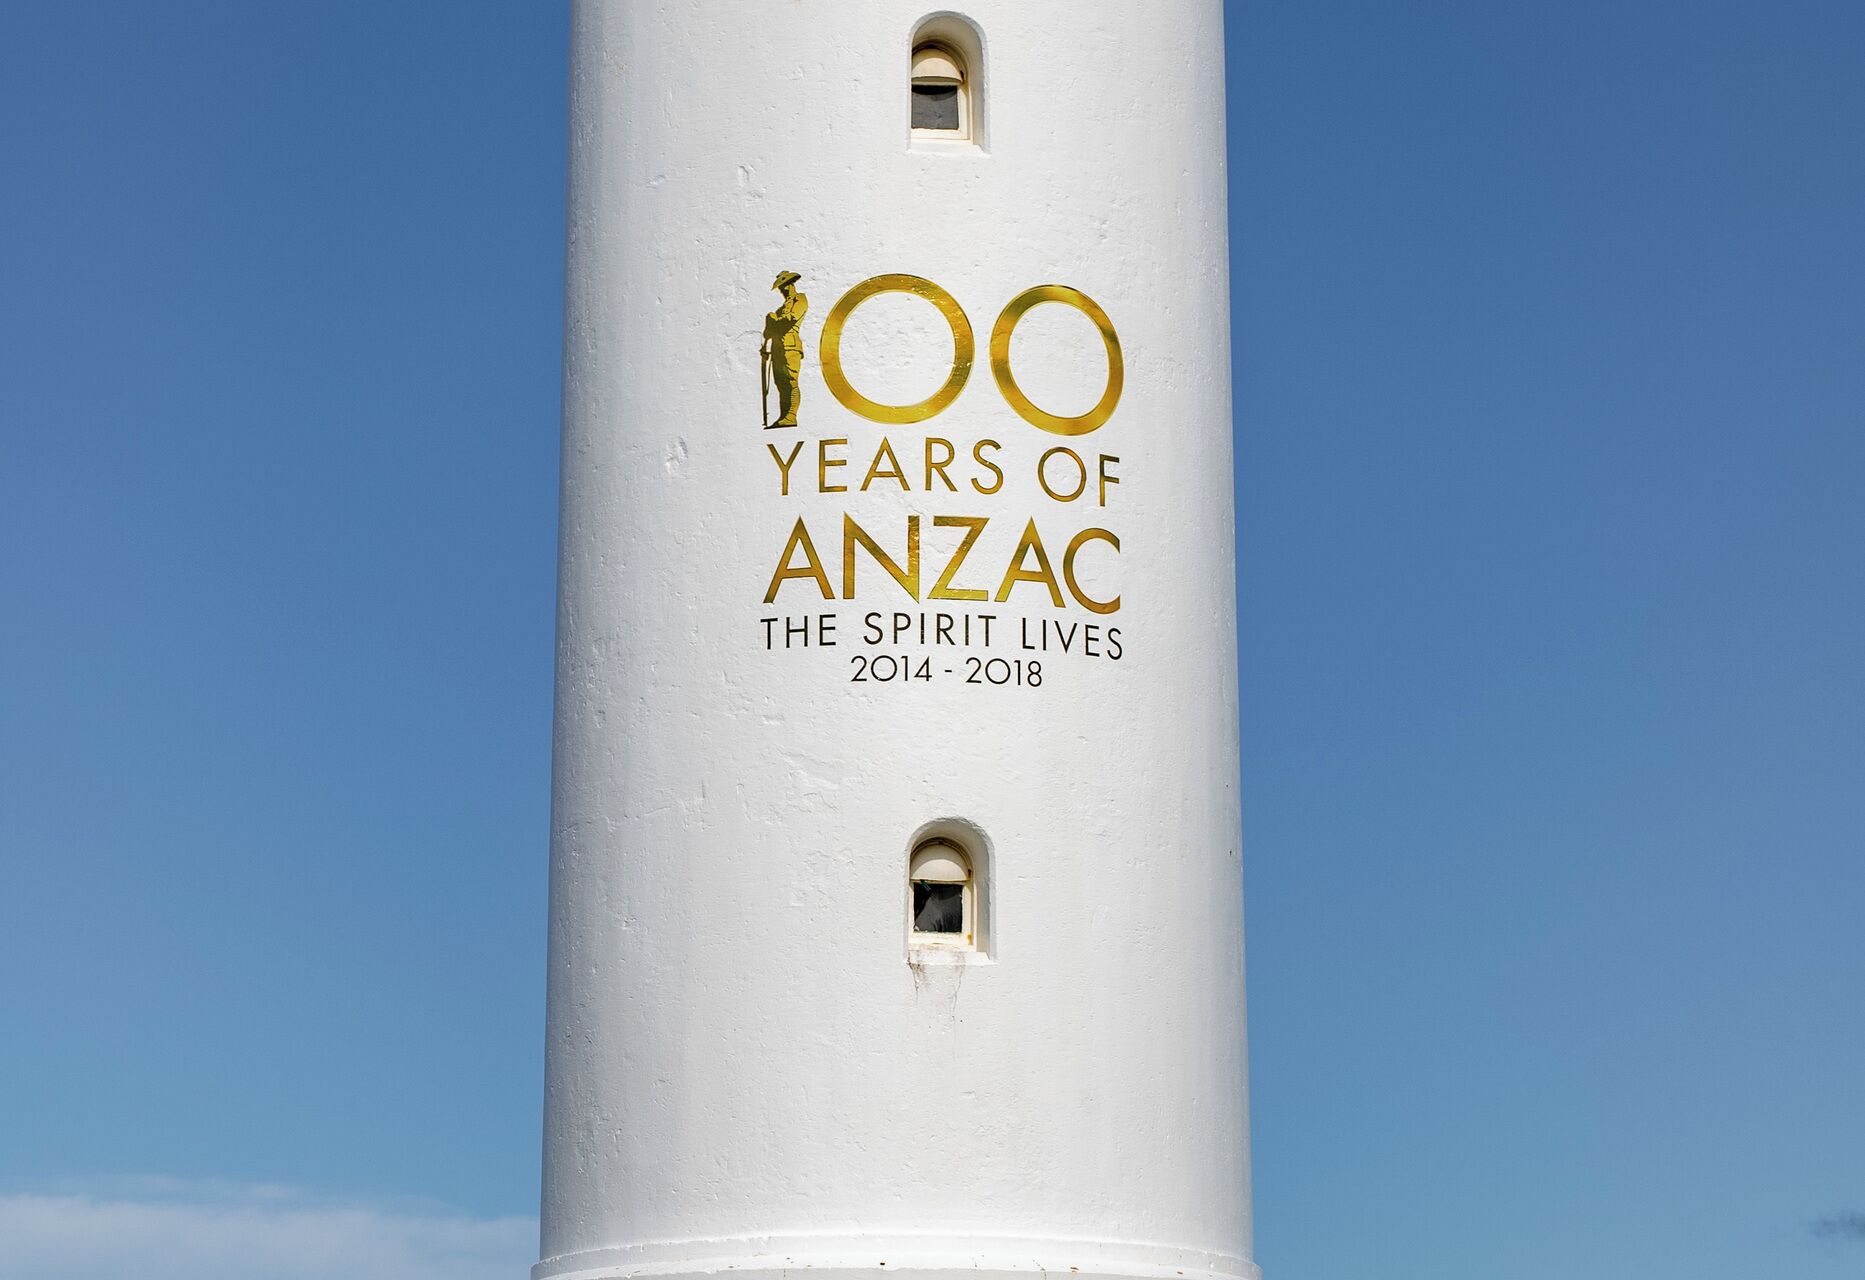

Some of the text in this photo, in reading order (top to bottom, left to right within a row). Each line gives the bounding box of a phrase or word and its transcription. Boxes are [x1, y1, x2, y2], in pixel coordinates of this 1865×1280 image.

[767, 436, 1120, 507] YEARS OF
[763, 512, 1121, 614] ANZAC
[760, 612, 1123, 660] THE SPIRIT LIVES
[851, 655, 932, 682] 2014
[965, 658, 1042, 687] 2018
